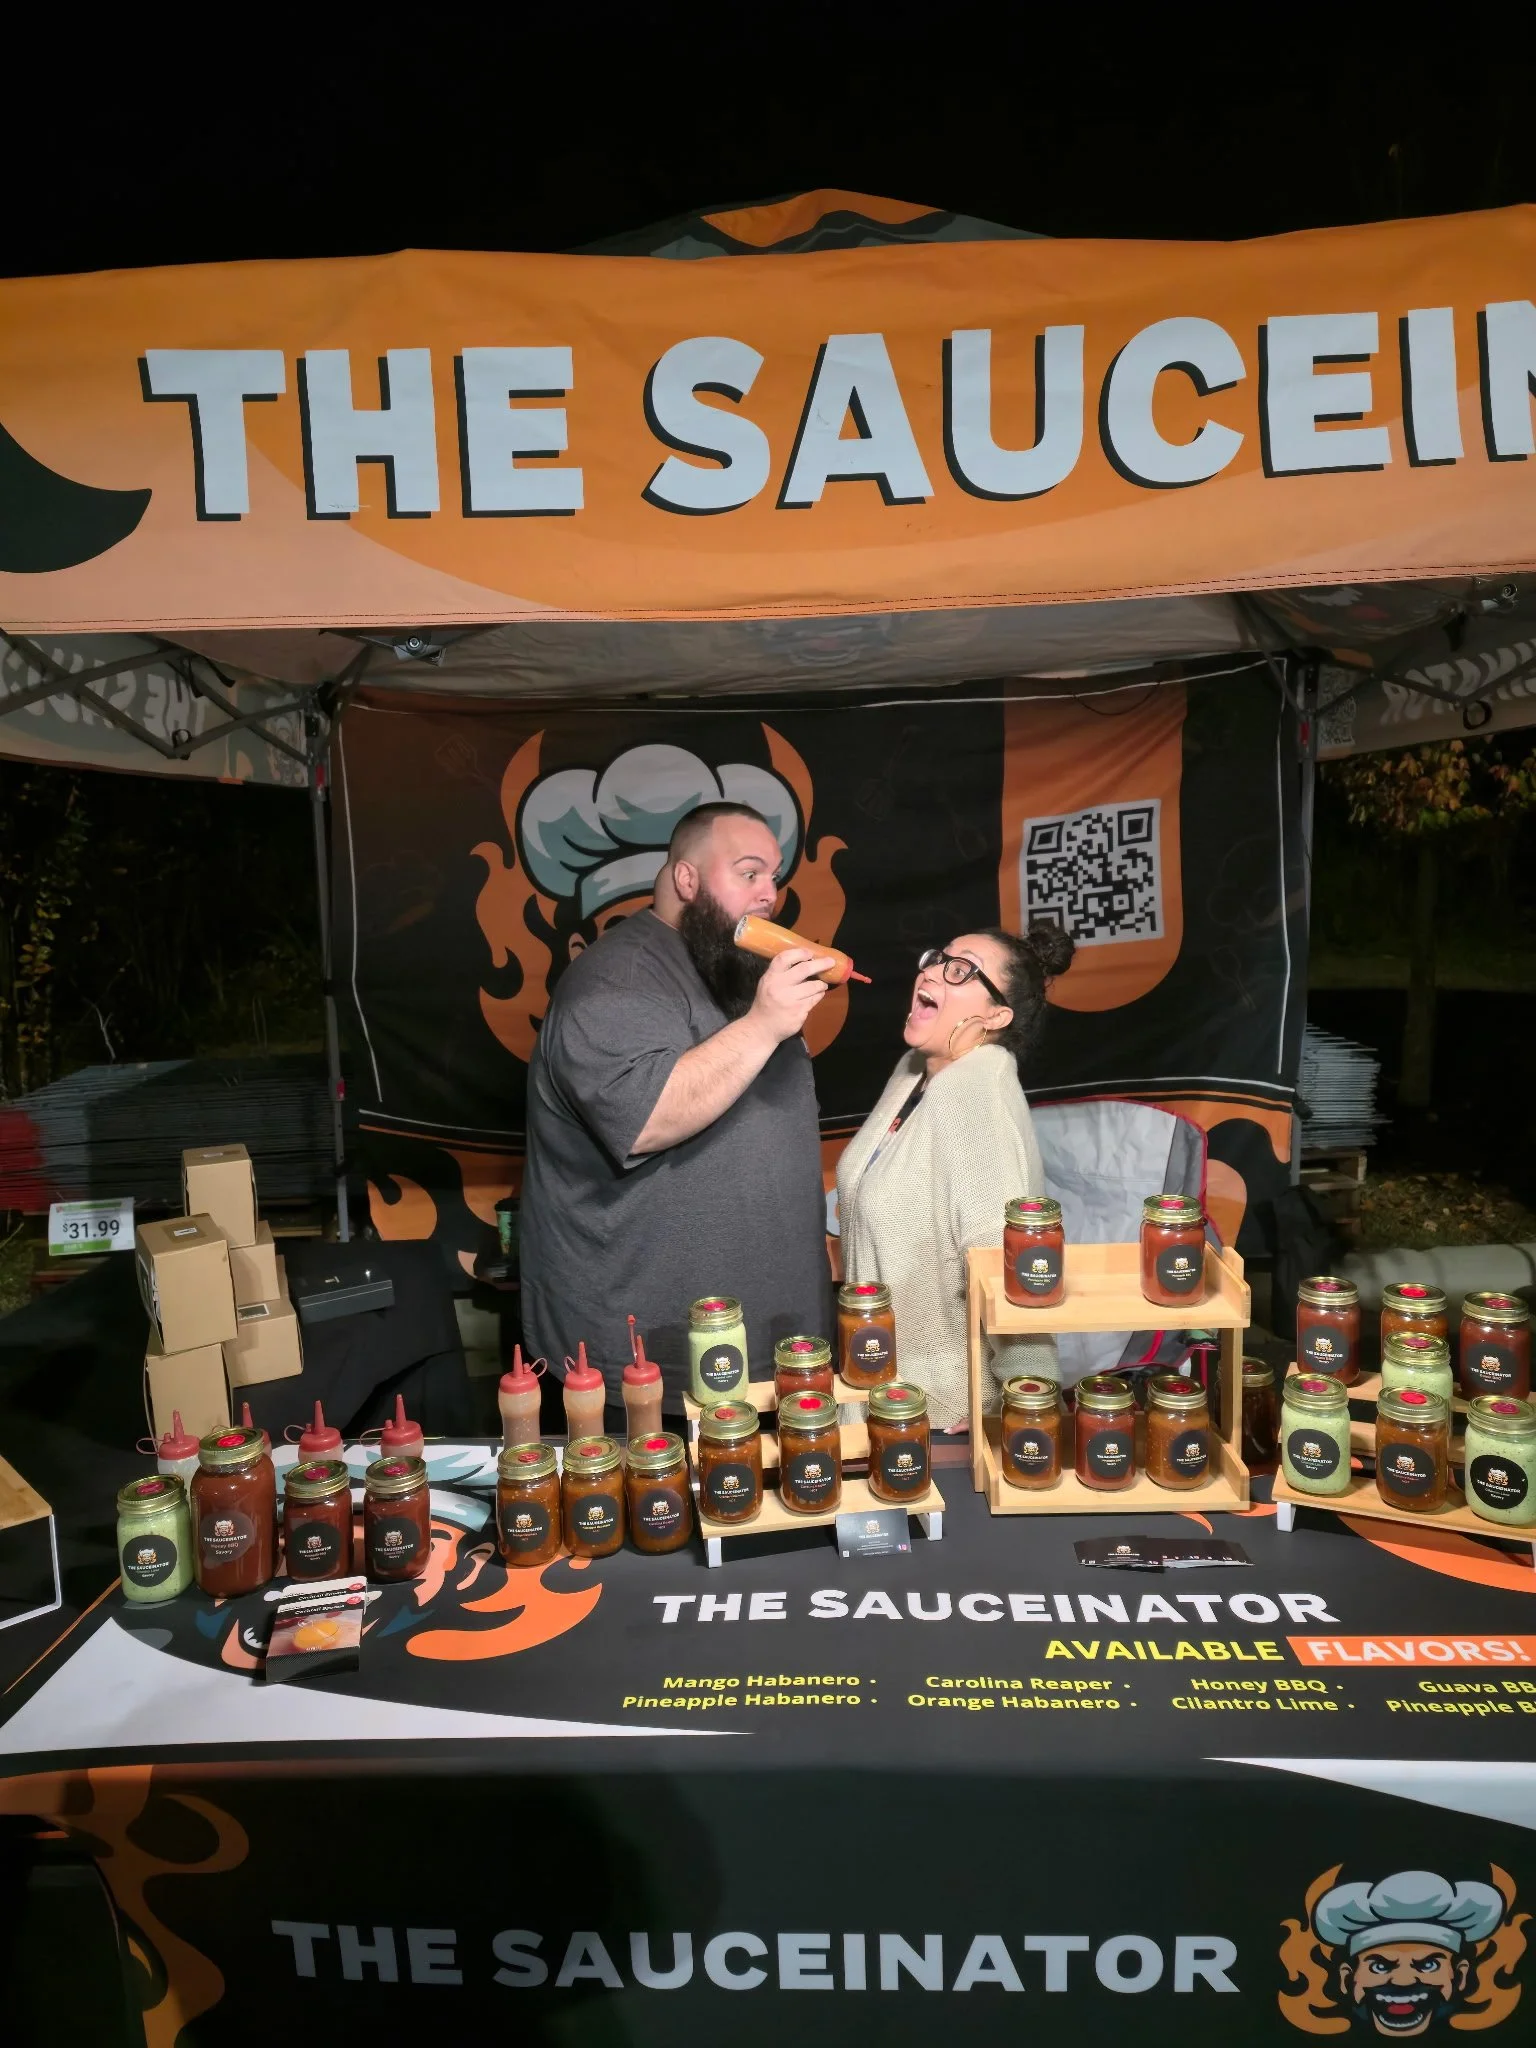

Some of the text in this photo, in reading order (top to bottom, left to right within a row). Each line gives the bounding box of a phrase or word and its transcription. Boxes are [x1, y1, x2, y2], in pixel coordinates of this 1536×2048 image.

[138, 346, 584, 521] THE
[62, 1219, 120, 1239] $31.99
[652, 1589, 1341, 1624] THE SAUCEINATOR
[1044, 1639, 1531, 1662] AVAILABLE FLAVORS!
[663, 1674, 860, 1692] Mango Habanero
[925, 1676, 1112, 1693] Carolina Reaper
[1191, 1678, 1328, 1694] Honey BBQ
[1418, 1681, 1498, 1693] Guava
[622, 1692, 861, 1710] Pineapple Habanero
[907, 1695, 1120, 1711] Orange Habanero
[1172, 1697, 1338, 1711] Cilantro Lime
[1386, 1700, 1514, 1716] Pineapple
[270, 1919, 1240, 1994] THE SAUCEINATOR
